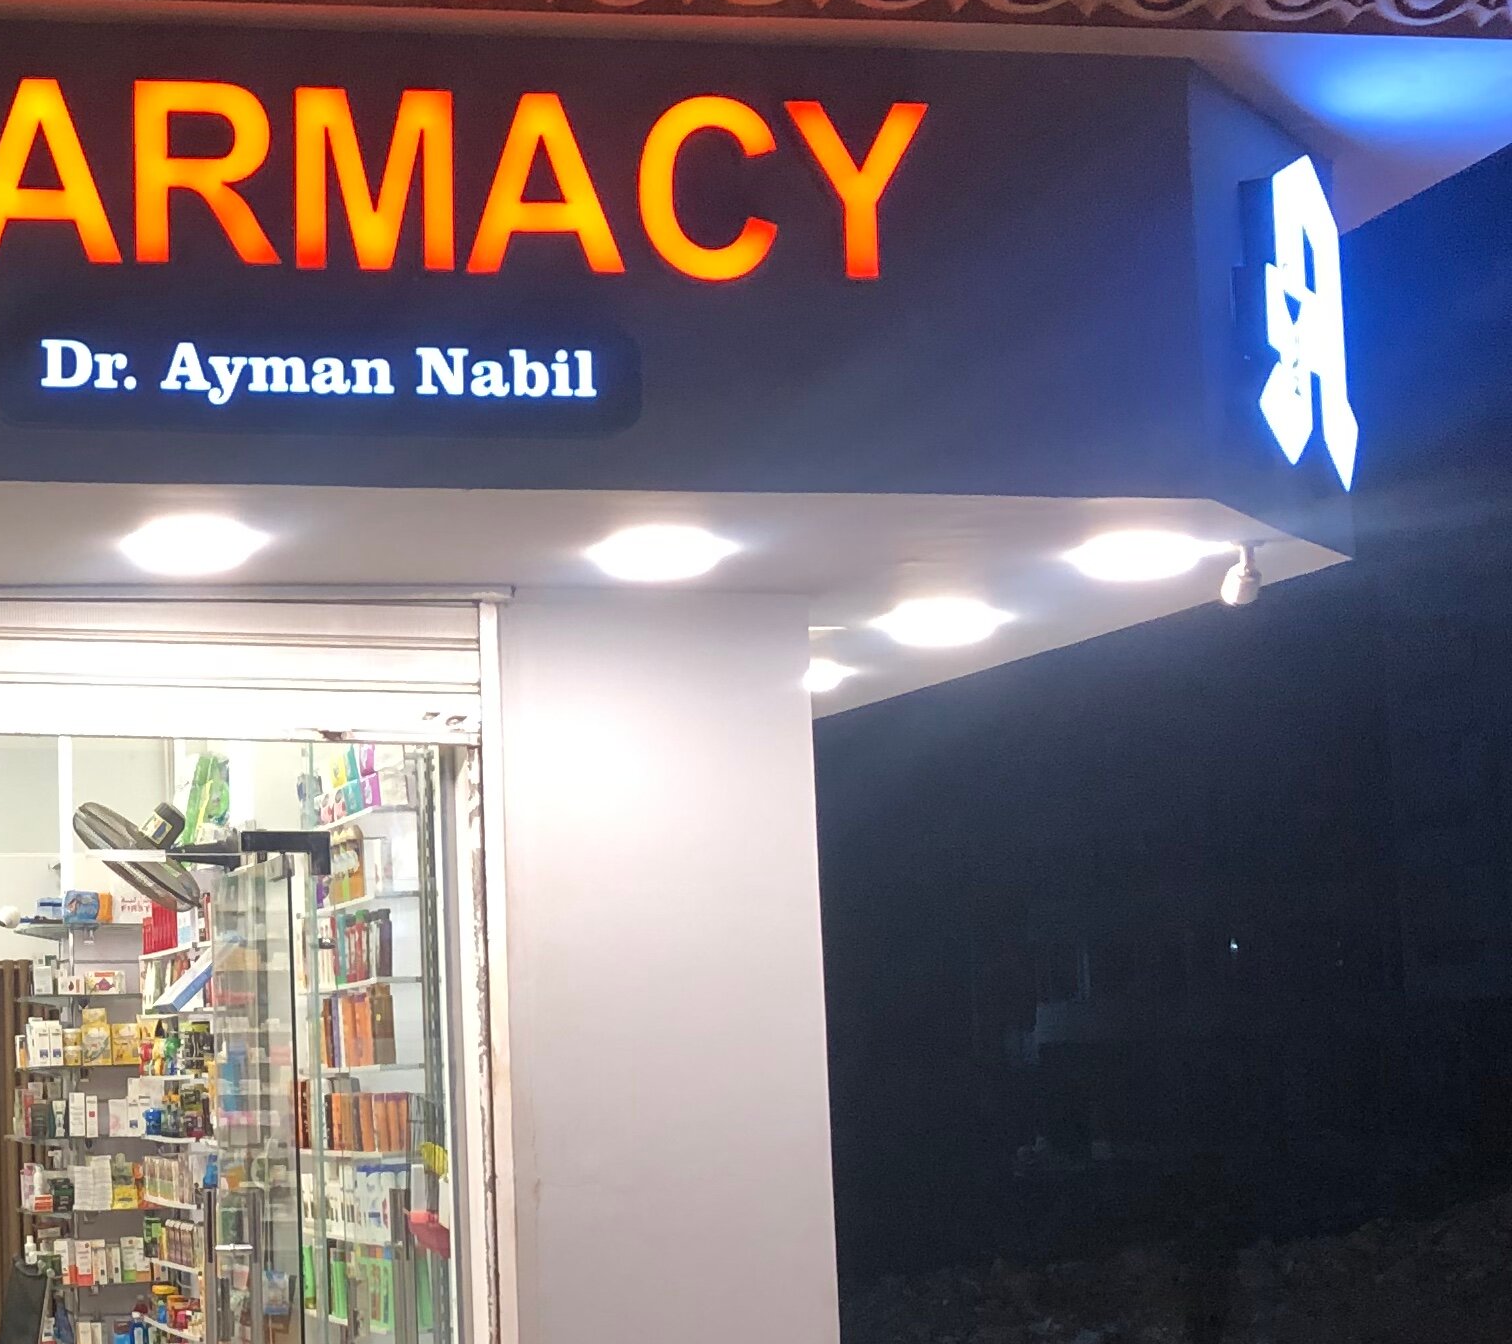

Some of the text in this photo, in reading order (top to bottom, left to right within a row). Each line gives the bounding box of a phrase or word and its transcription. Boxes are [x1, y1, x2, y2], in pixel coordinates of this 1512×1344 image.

[40, 338, 597, 405] Dr. Ayman Nabil
